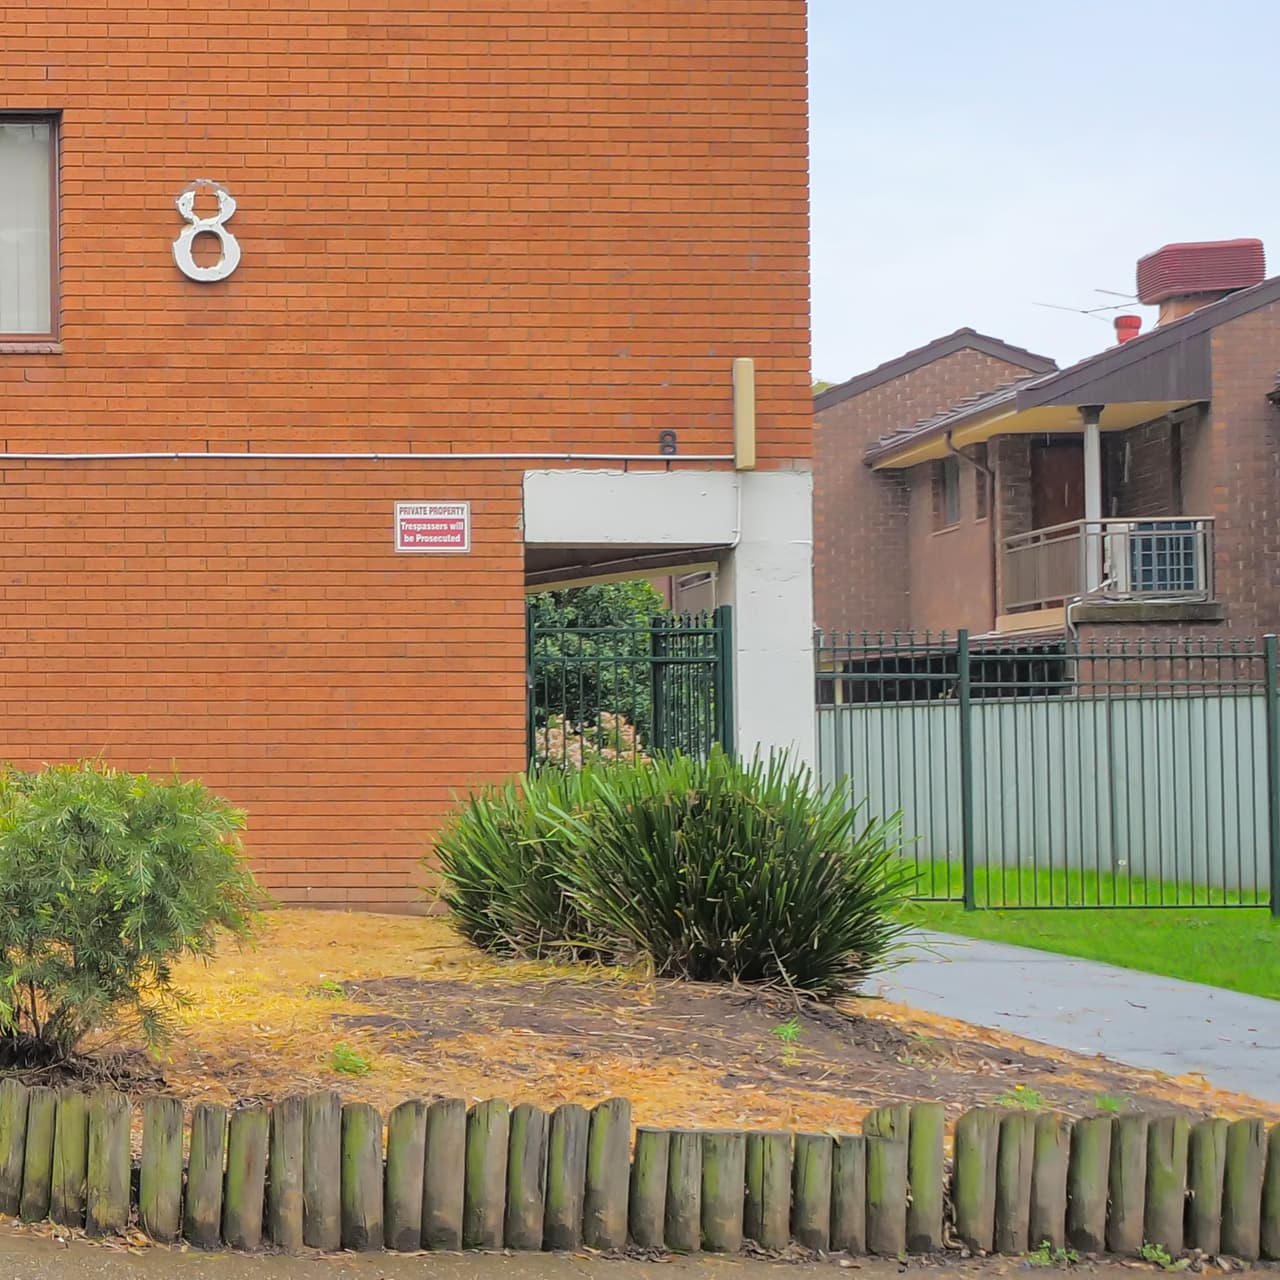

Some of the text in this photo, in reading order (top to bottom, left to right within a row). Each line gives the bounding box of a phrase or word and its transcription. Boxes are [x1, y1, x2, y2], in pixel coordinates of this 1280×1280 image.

[172, 179, 241, 281] 8
[399, 506, 465, 515] PRIVATE PROPERTY
[400, 522, 464, 531] Trespassers will
[403, 534, 461, 542] be Prosecuted
